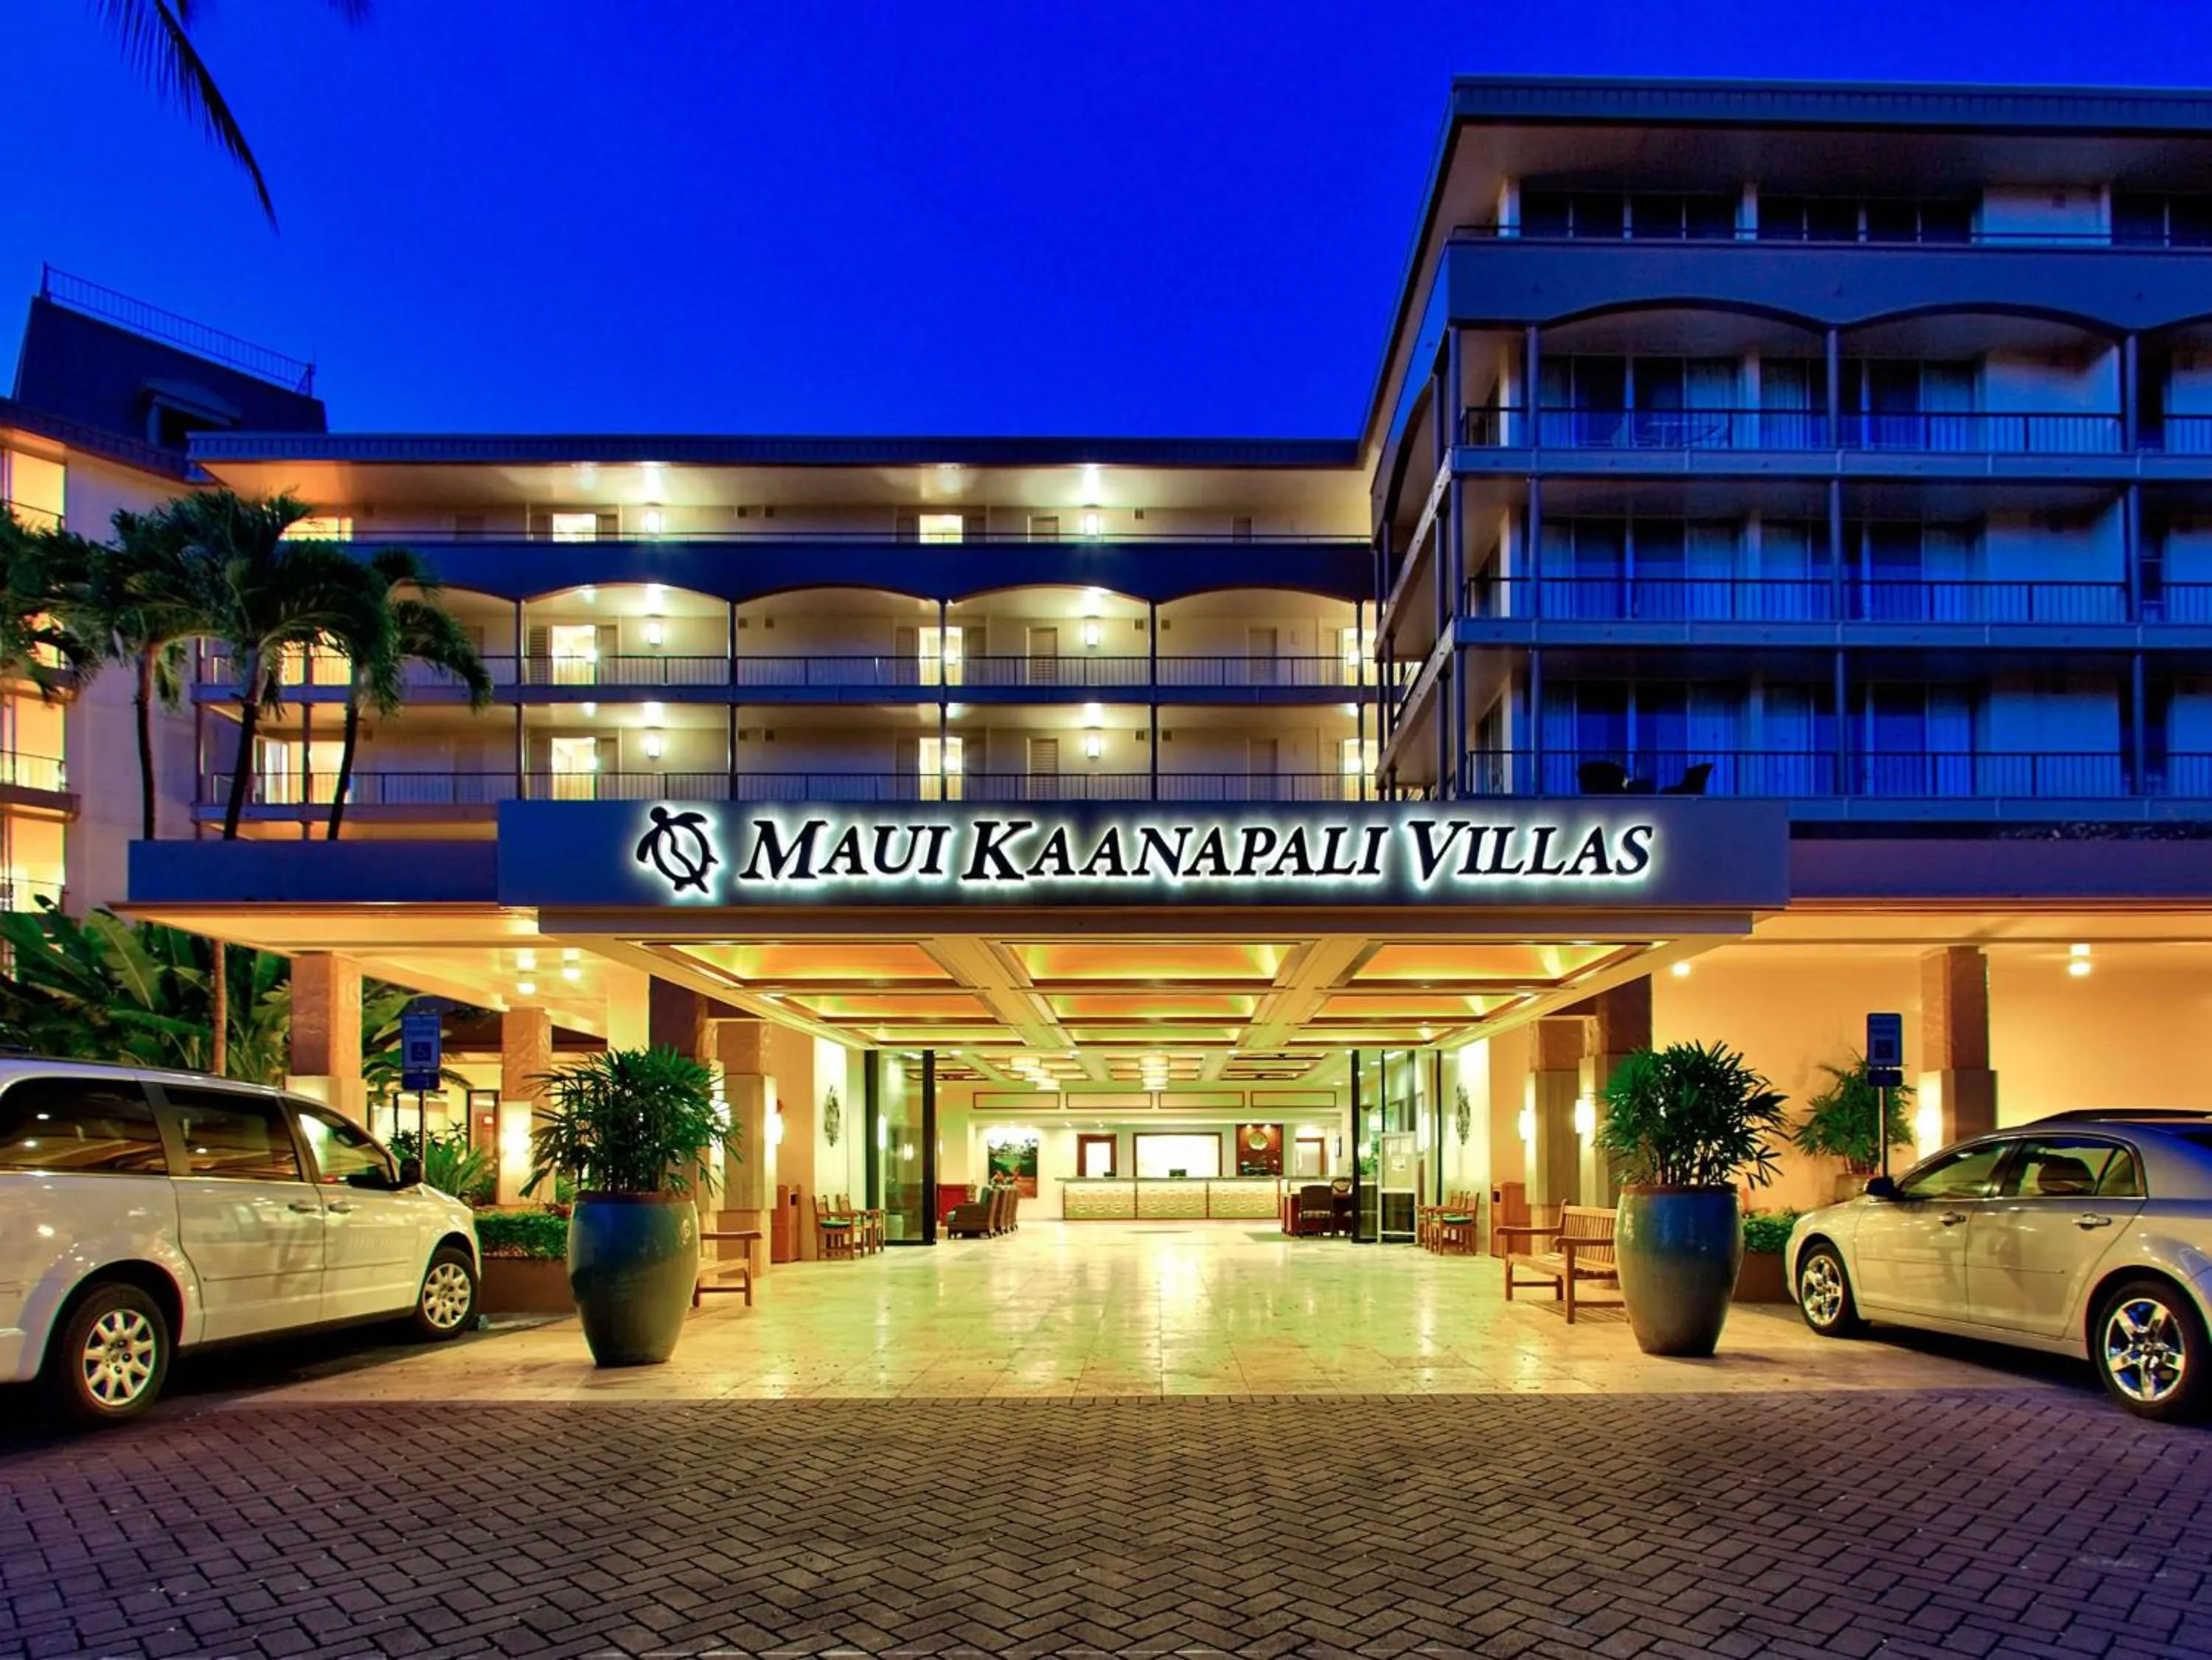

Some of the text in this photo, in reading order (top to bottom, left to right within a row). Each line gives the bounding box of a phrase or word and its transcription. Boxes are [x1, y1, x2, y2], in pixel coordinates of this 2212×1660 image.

[739, 820, 1652, 882] MAUI KAANAPALI VILLAS
